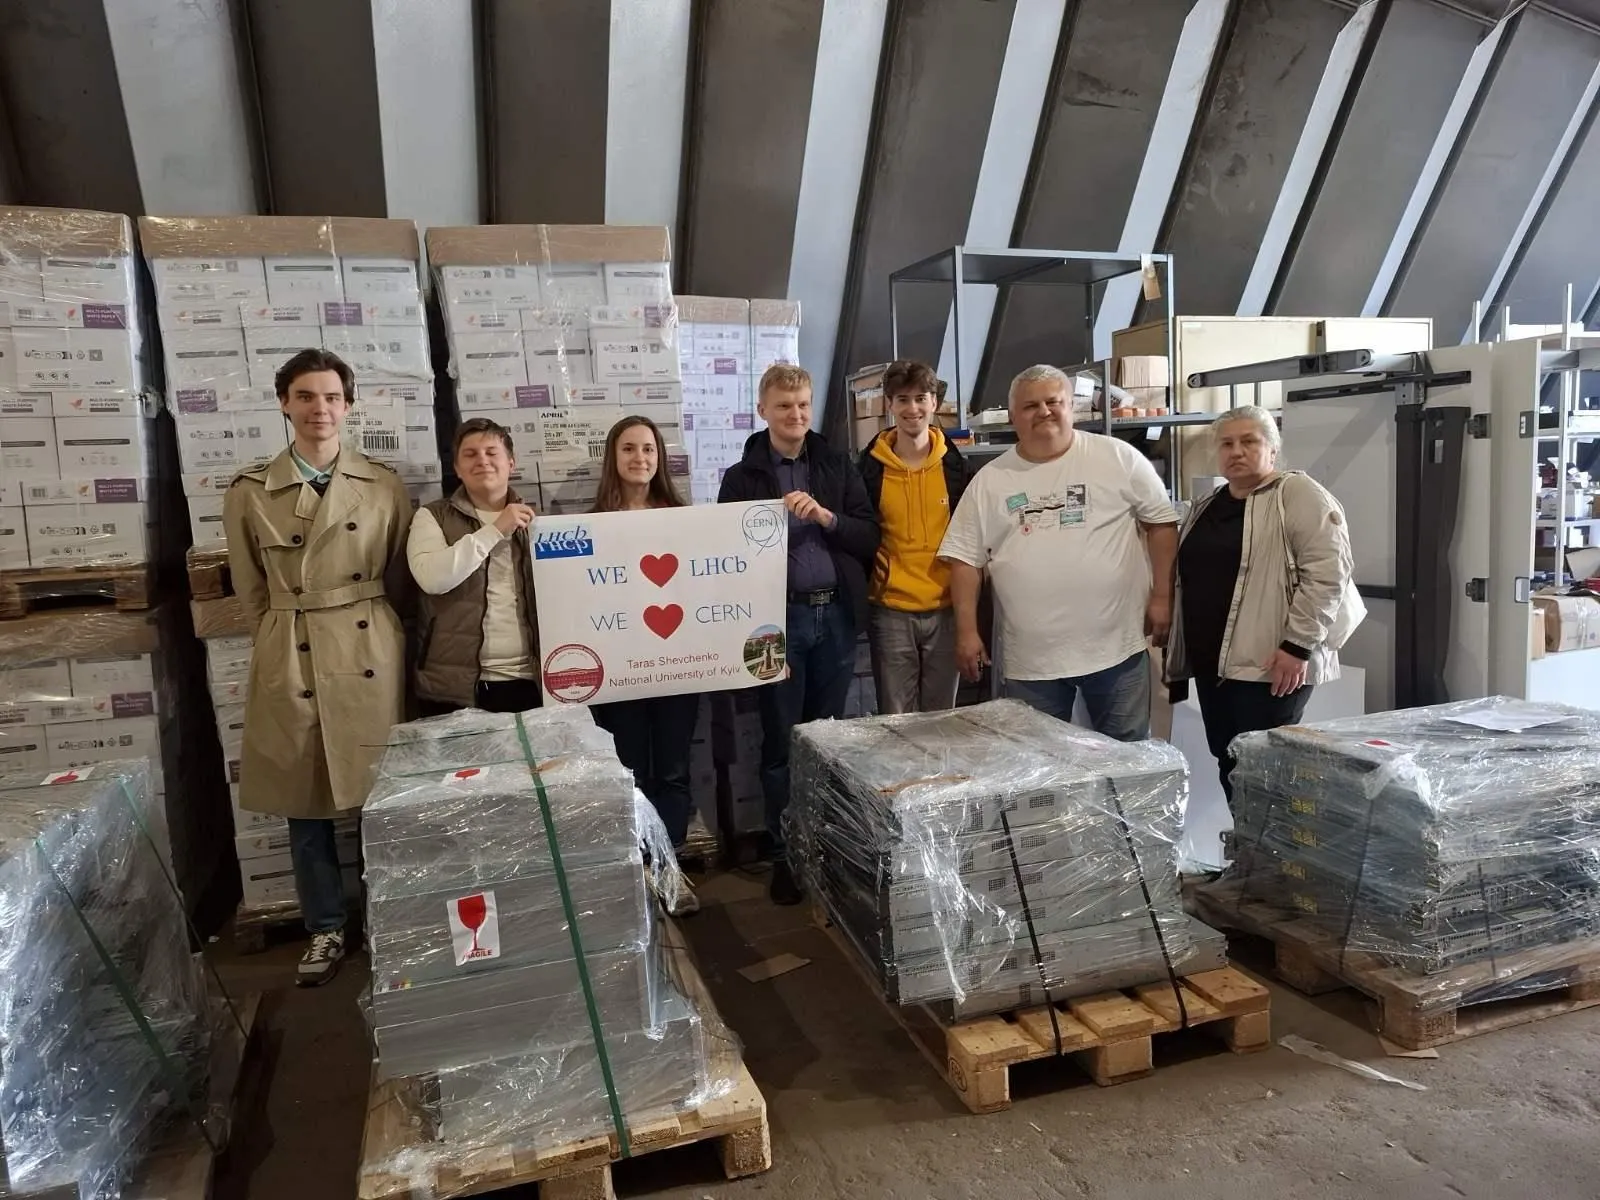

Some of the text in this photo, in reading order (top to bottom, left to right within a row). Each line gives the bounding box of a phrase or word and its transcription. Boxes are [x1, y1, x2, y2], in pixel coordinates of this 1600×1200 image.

[746, 518, 773, 528] CERN
[537, 525, 587, 542] LHCb
[587, 556, 748, 585] WE LHCb
[590, 602, 752, 632] WE CERN
[627, 652, 719, 670] Taras Shevchenko
[609, 664, 741, 687] National University of Kyiv
